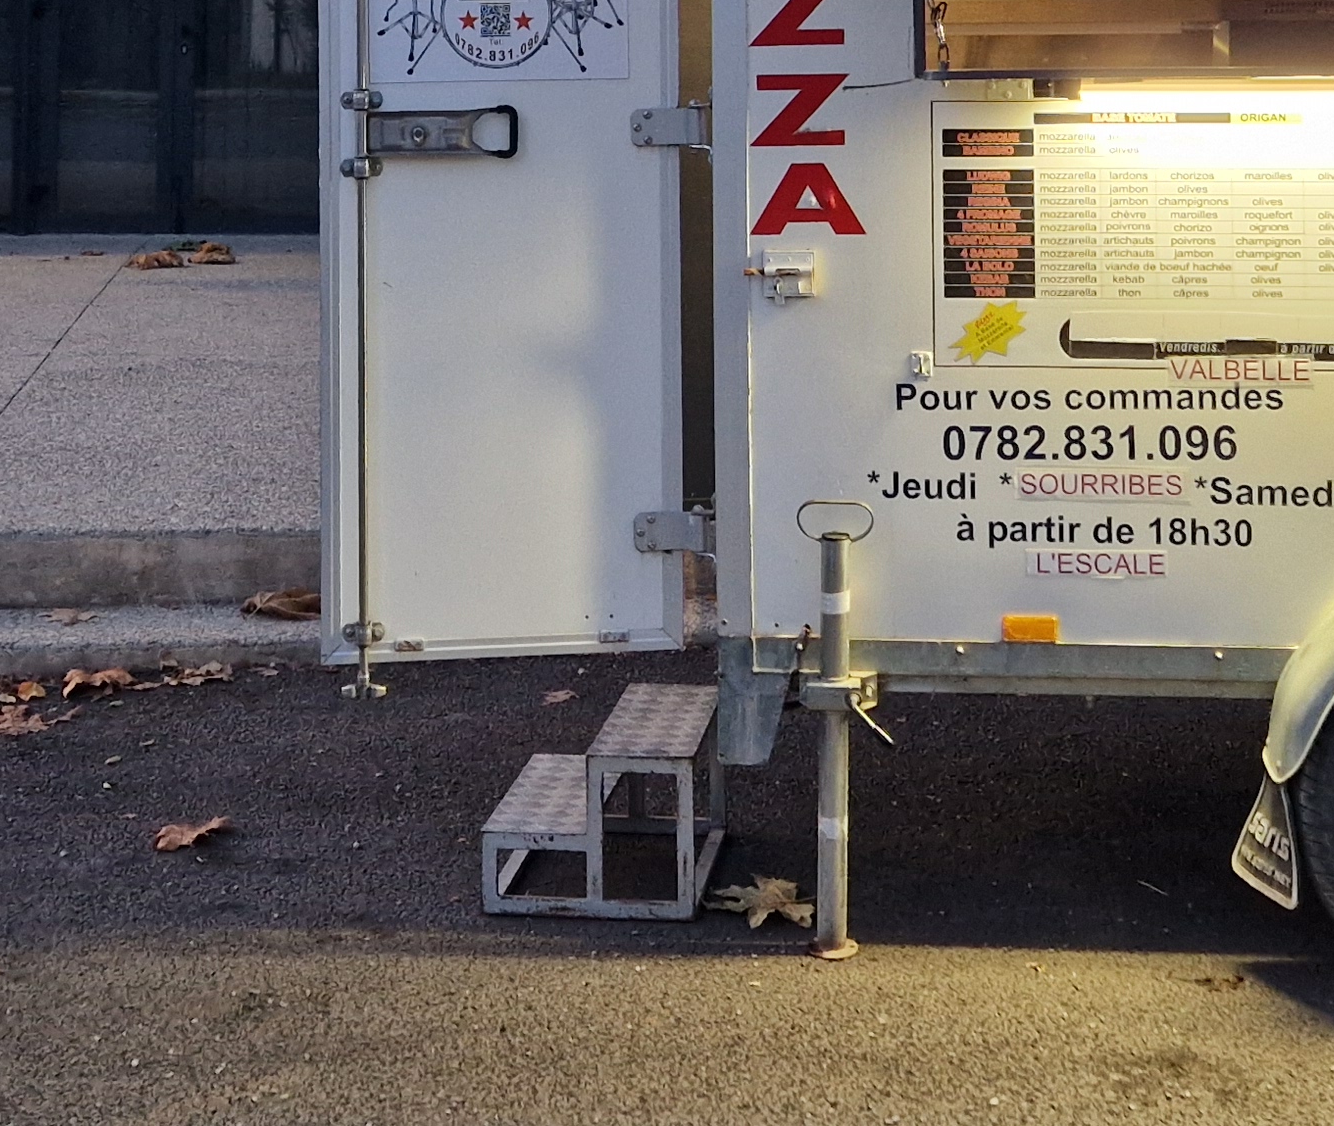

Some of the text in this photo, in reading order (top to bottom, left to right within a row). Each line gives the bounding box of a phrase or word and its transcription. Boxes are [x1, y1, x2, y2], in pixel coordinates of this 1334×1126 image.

[455, 32, 539, 61] 0782.831.096
[1039, 146, 1096, 154] mozzarella
[1040, 172, 1097, 180] mozzarella
[1110, 171, 1148, 180] lardons
[1170, 172, 1214, 180] chorizos
[1245, 172, 1292, 180] maroilles
[1040, 185, 1097, 193] mozzarella
[1109, 184, 1148, 195] jambon
[1178, 185, 1208, 193] olives
[1040, 197, 1097, 205] mozzarella
[1109, 197, 1149, 207] jambon
[1158, 197, 1229, 208] champignons
[1252, 198, 1283, 206] olives
[1040, 211, 1097, 219] mozzarella
[1111, 210, 1146, 219] chèvre
[1170, 211, 1218, 219] maroilles
[1244, 211, 1293, 220] roquefort
[1106, 223, 1151, 231] poivrons
[1173, 224, 1212, 232] chorizo
[1250, 224, 1289, 233] oignons
[1040, 237, 1097, 245] mozzarella
[1103, 236, 1154, 245] artichauts
[1170, 237, 1216, 247] poivrons
[1236, 238, 1301, 247] champignon
[1040, 249, 1097, 258] mozzarella
[1103, 249, 1154, 258] artichauts
[1174, 250, 1213, 260] jambon
[1236, 251, 1301, 261] champignon
[1040, 262, 1097, 271] mozzarella
[1105, 262, 1140, 271] viande
[1143, 262, 1156, 271] de
[1160, 263, 1190, 271] boeuf
[1192, 263, 1232, 271] hachée
[1254, 264, 1278, 272] oeuf
[1113, 274, 1145, 283] kebab
[1172, 276, 1208, 285] câpres
[1251, 276, 1281, 284] olives
[1041, 288, 1097, 297] mozzarella
[1118, 288, 1141, 297] thon
[1173, 289, 1210, 298] câpres
[1252, 289, 1283, 298] olives
[1171, 360, 1310, 381] VALBELLE
[896, 383, 1284, 411] Pour vos commandes
[942, 425, 1238, 462] 0782.831.096
[1020, 473, 1183, 497] SOURRIBES
[956, 516, 1253, 547] à partir de 18h30
[1036, 552, 1166, 577] L'ESCALE
